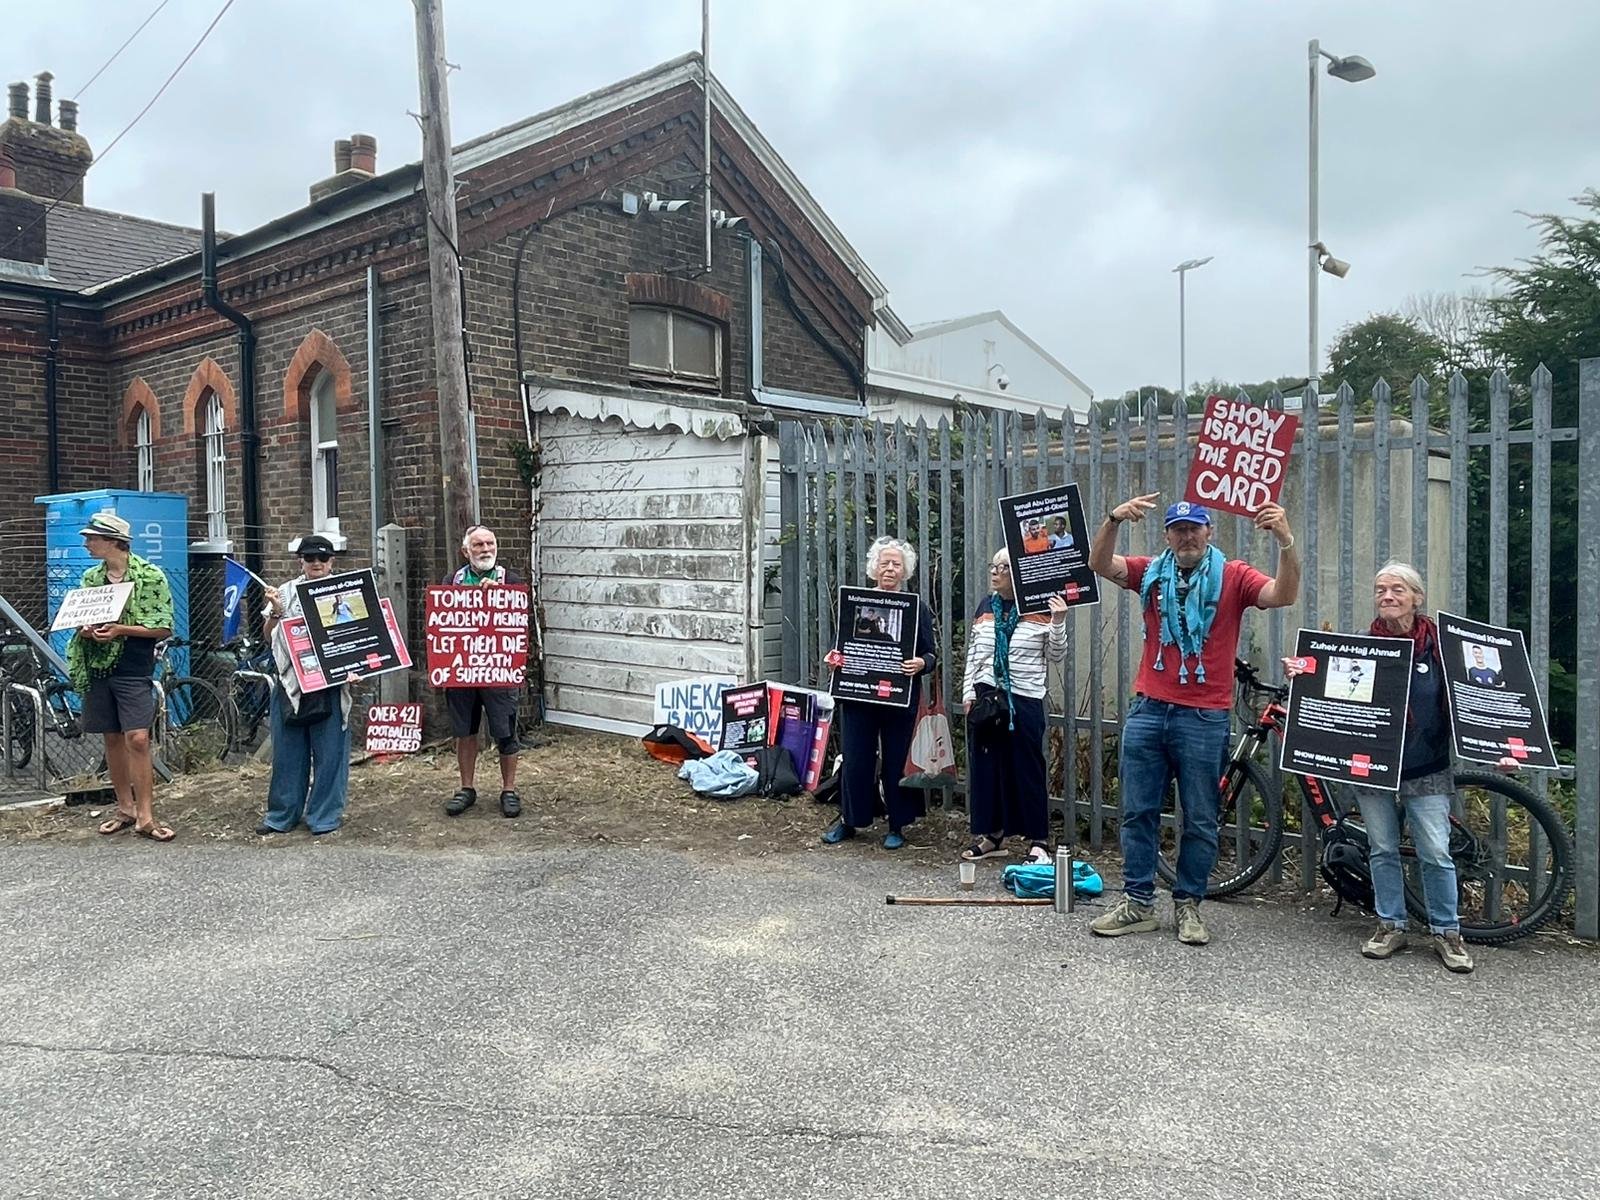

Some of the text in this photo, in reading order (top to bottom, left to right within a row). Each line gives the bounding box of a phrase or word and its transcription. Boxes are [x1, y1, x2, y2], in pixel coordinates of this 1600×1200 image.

[1213, 399, 1285, 434] SHOW
[1204, 418, 1285, 457] ISRAEL
[1198, 442, 1281, 484] THE RED
[1195, 470, 1271, 512] CARD
[71, 586, 115, 598] FOOTBALL
[80, 594, 114, 605] ALWAYS
[430, 589, 528, 609] TOMER HEMED
[62, 606, 113, 618] POLITICAL
[428, 610, 528, 627] ACADEMY MENTOR
[462, 634, 496, 654] THEM
[502, 634, 528, 654] DIE
[1310, 640, 1338, 652] Zuheir
[1368, 648, 1401, 658] Ahmad
[452, 654, 512, 668] A DEATH
[431, 668, 451, 686] OF
[661, 683, 736, 710] LINEKE
[368, 706, 420, 724] OVER 421
[668, 710, 722, 730] IS NOW
[366, 738, 420, 752] MURDERED
[1294, 750, 1314, 760] SHOW
[1314, 754, 1338, 764] ISRAEL
[1338, 758, 1352, 766] THE
[1352, 760, 1368, 769] RED
[1368, 764, 1388, 772] CARD
